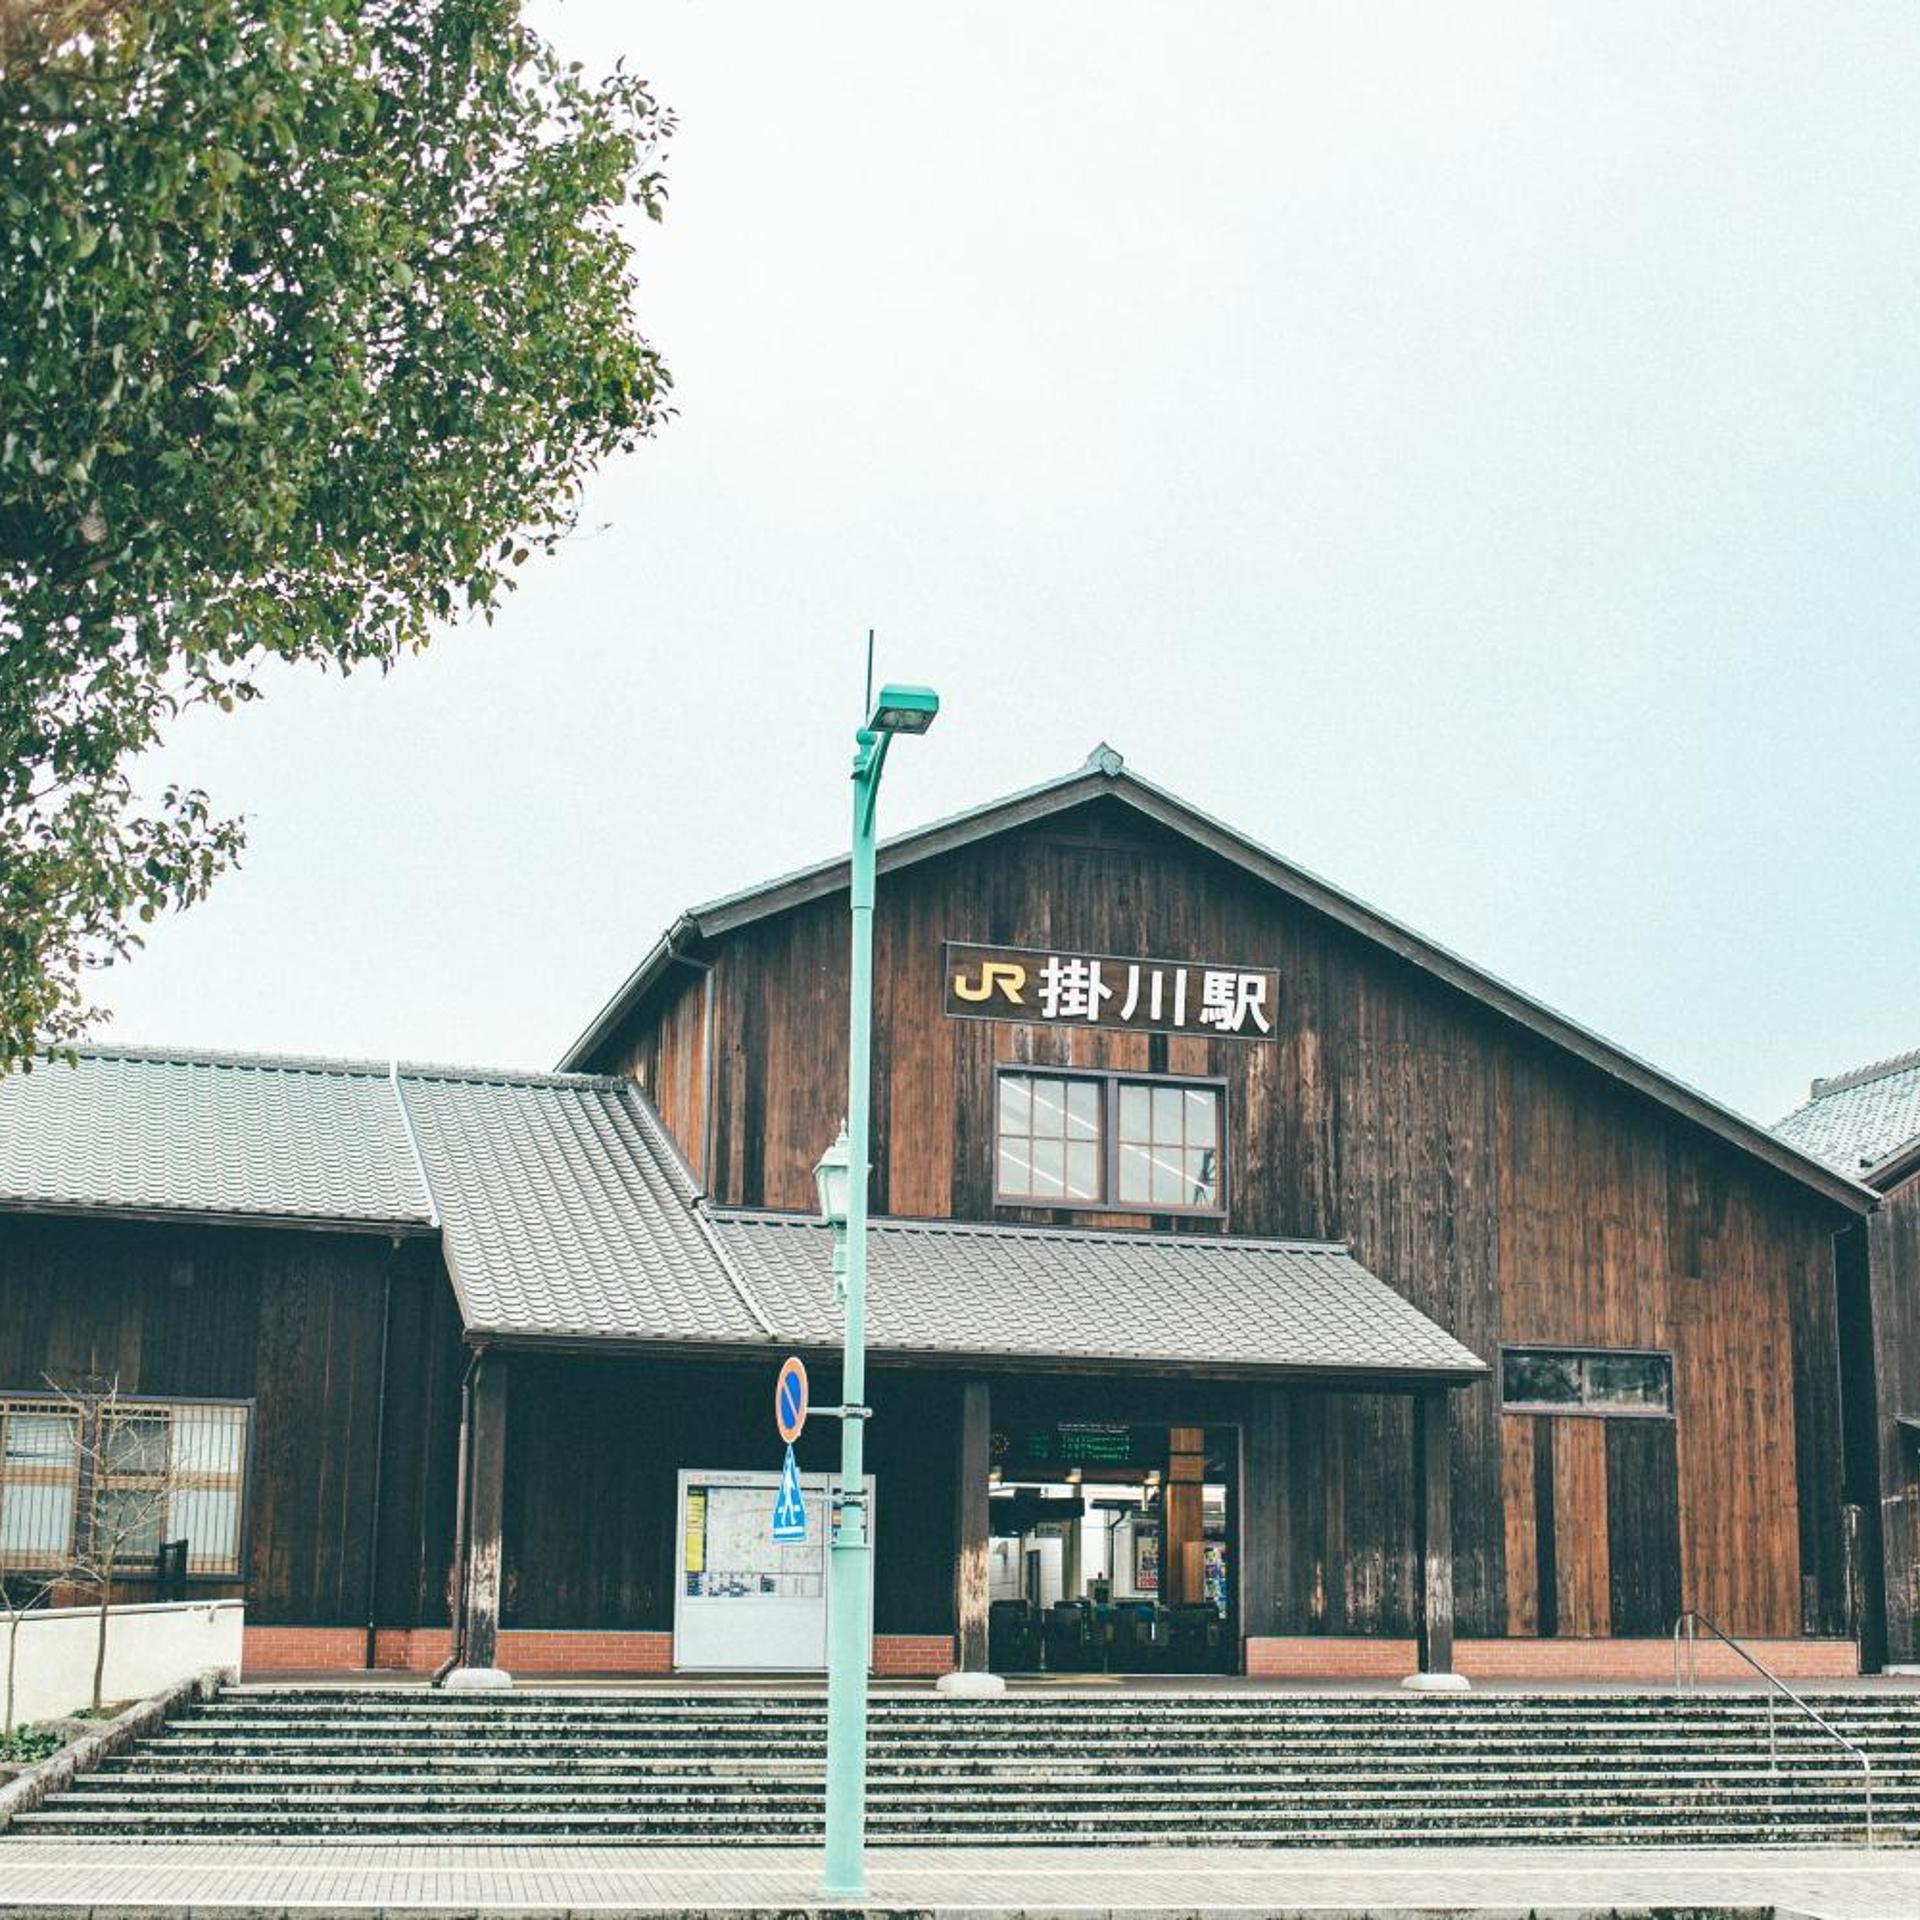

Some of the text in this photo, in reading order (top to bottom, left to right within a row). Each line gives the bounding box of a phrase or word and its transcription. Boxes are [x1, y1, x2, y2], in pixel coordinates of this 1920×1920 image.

[954, 957, 1270, 1034] JR 掛川駅
